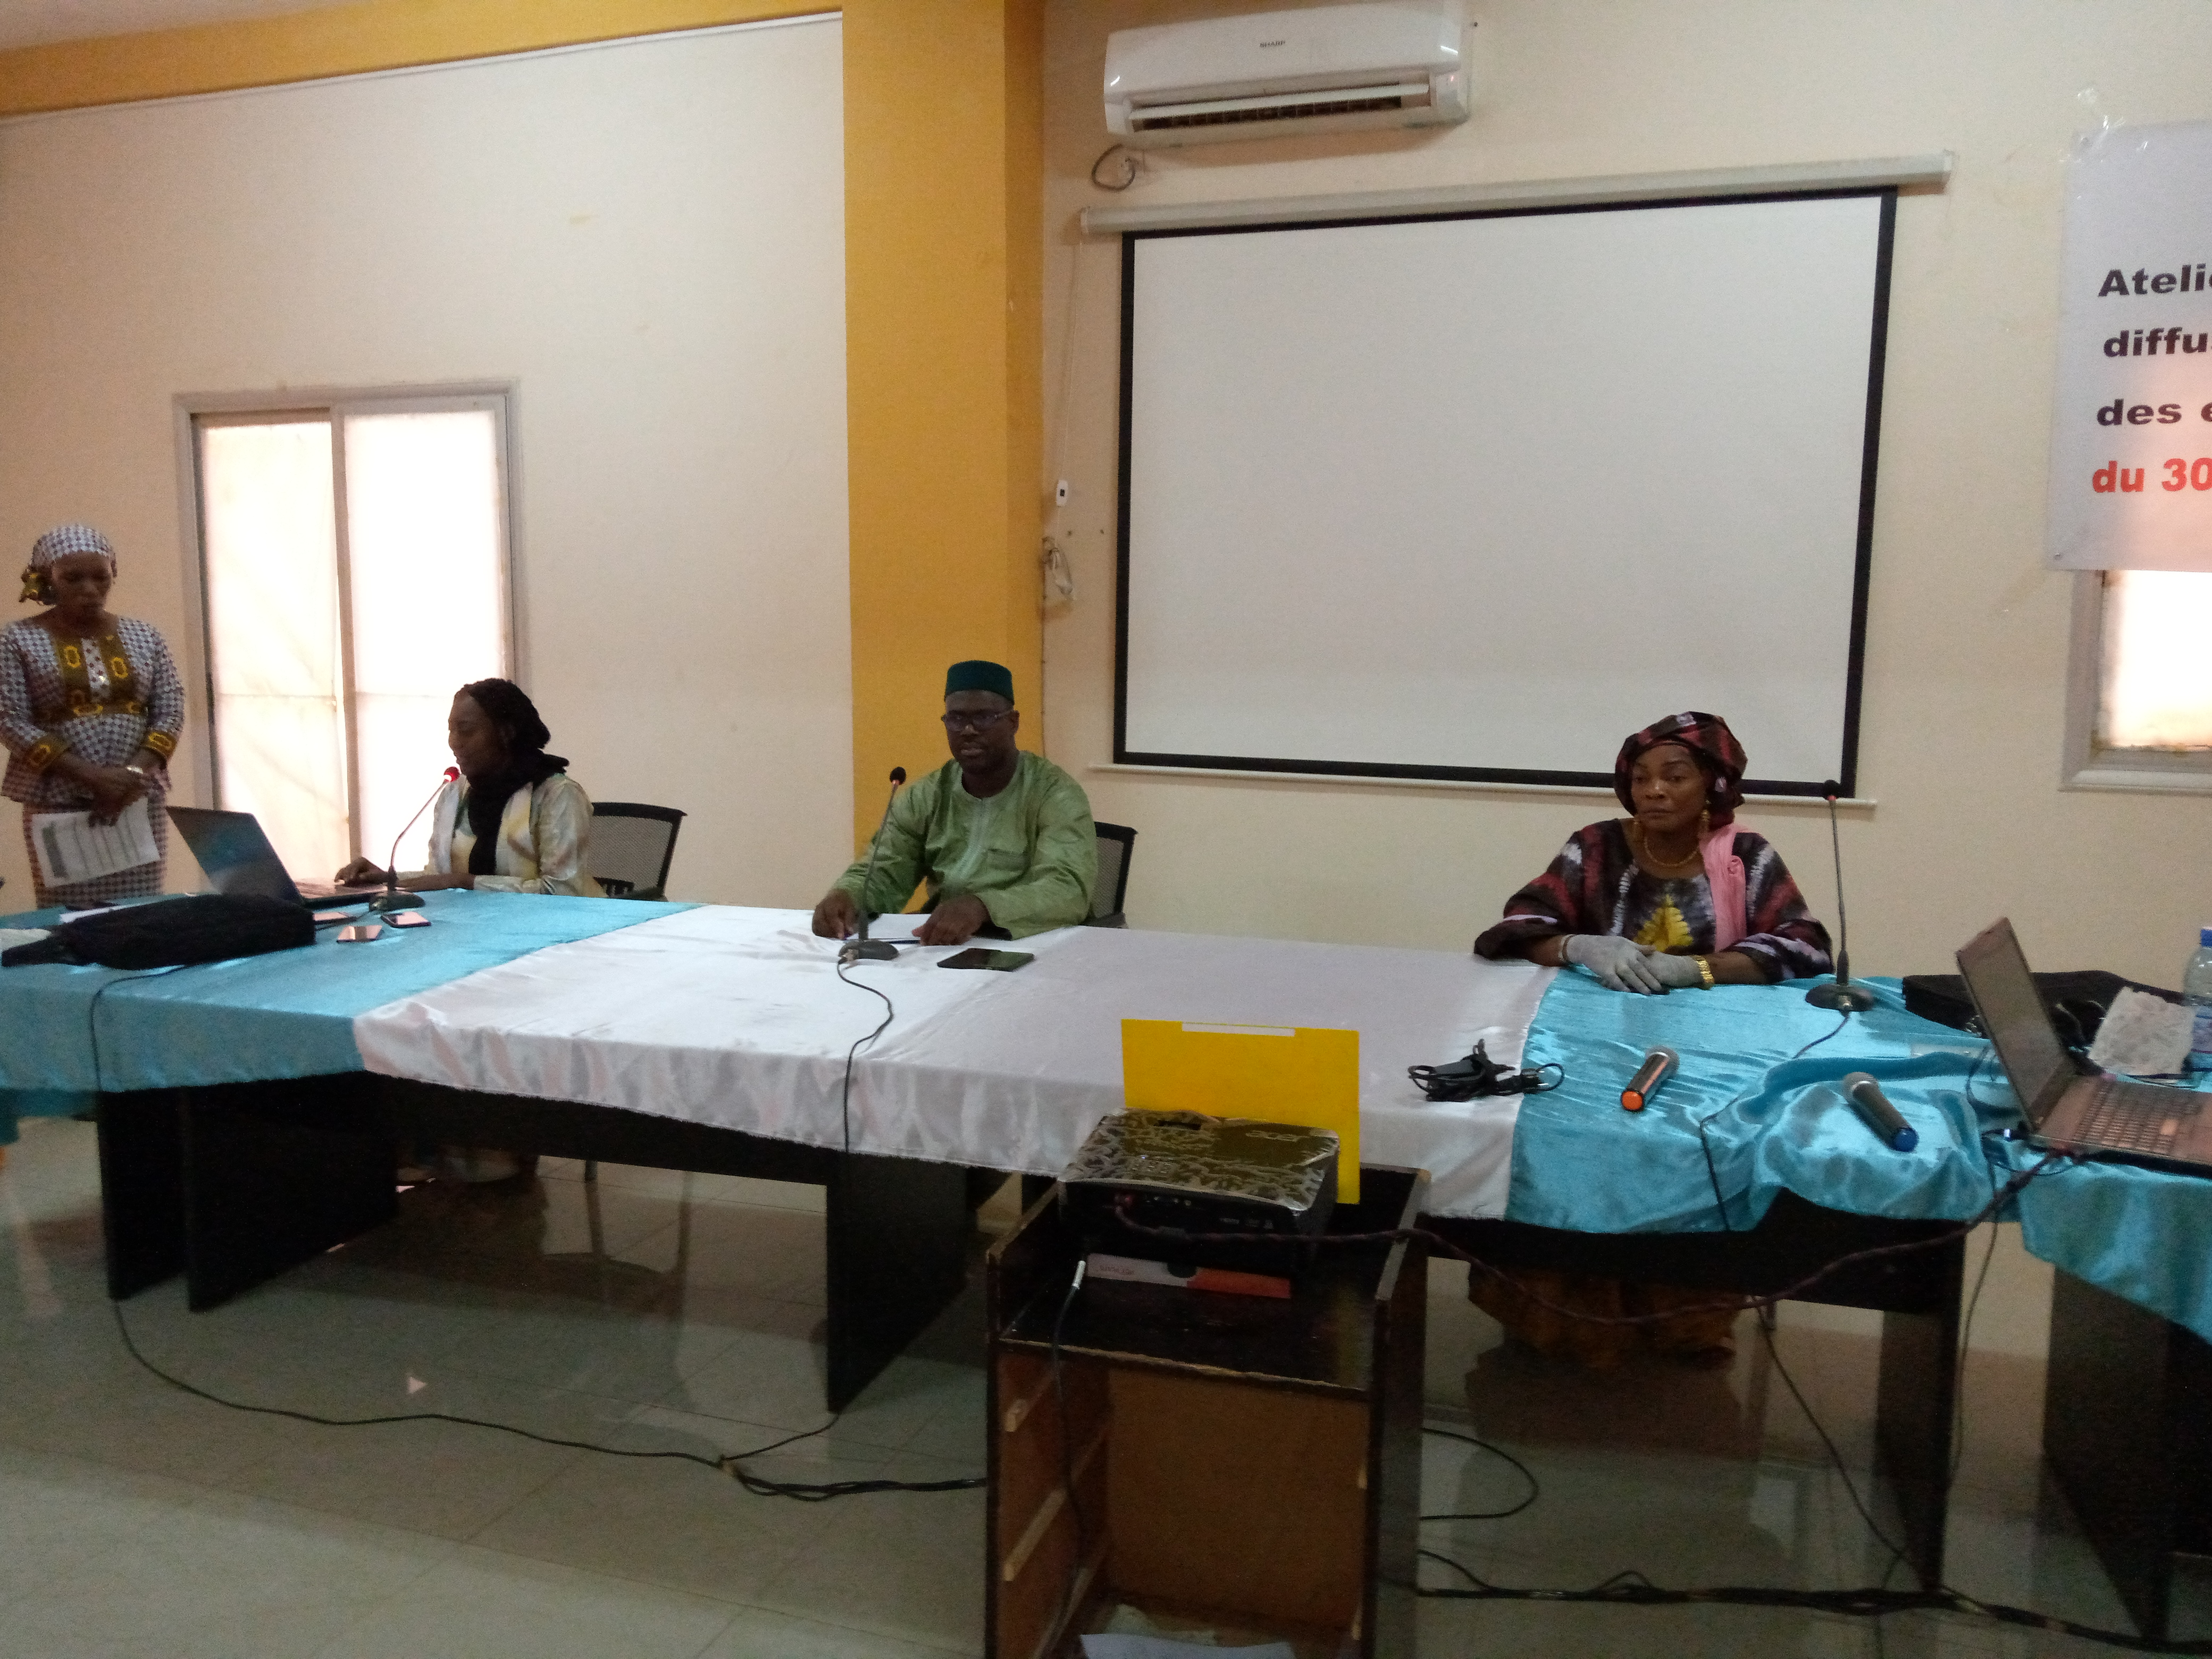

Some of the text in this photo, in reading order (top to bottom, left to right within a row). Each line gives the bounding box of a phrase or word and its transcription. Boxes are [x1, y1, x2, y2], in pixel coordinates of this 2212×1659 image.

[2098, 263, 2212, 297] Ateli
[2104, 326, 2212, 357] diffu
[2097, 398, 2182, 426] des
[2092, 457, 2212, 493] du 30
[1245, 1130, 1310, 1142] acer
